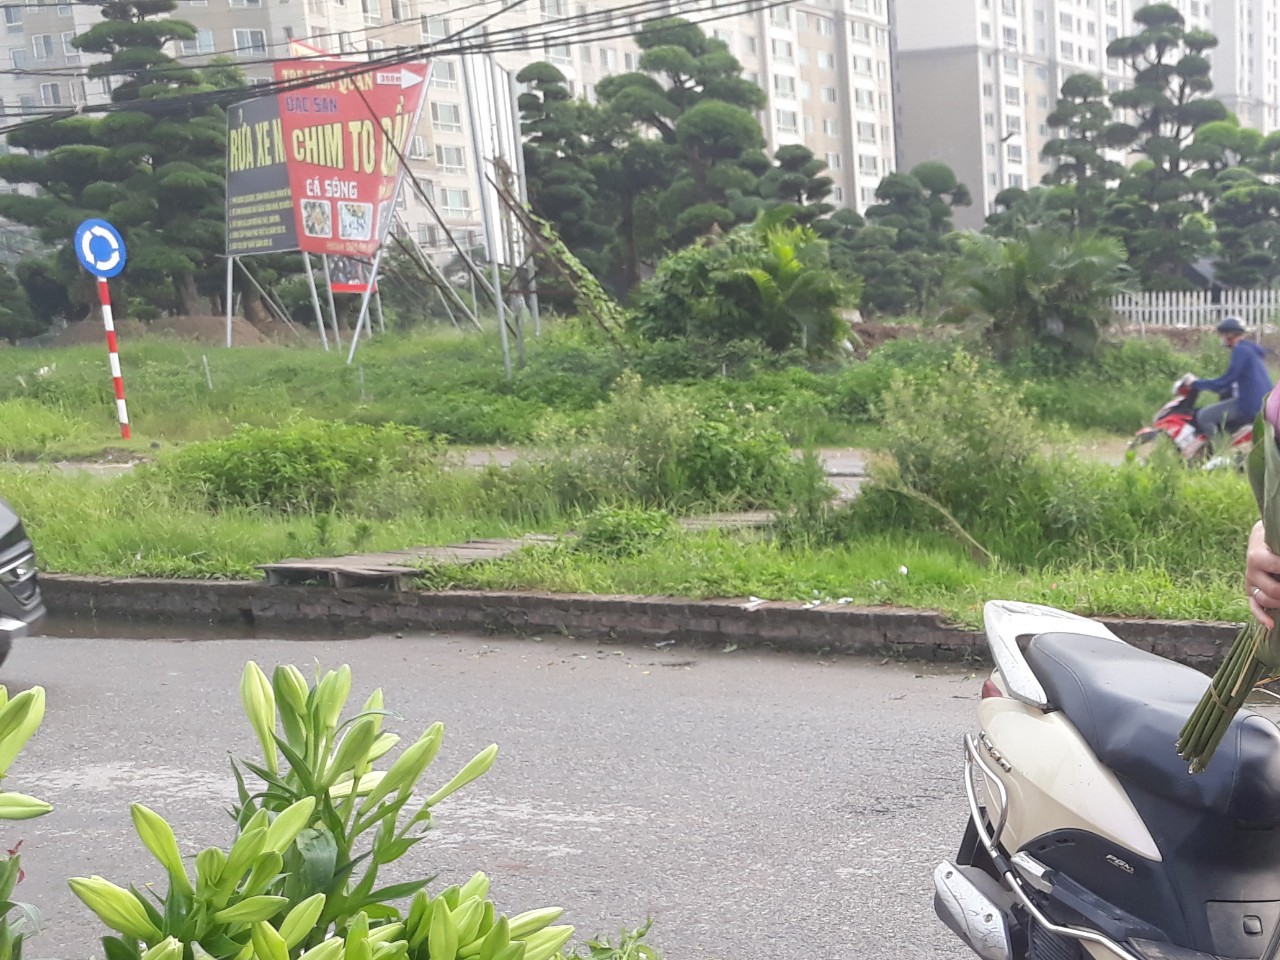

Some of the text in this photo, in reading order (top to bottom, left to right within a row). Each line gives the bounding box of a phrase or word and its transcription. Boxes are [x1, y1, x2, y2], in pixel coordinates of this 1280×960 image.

[255, 120, 273, 167] XE
[291, 122, 345, 170] CHIM
[348, 119, 376, 175] TO
[324, 178, 359, 199] SÔNG
